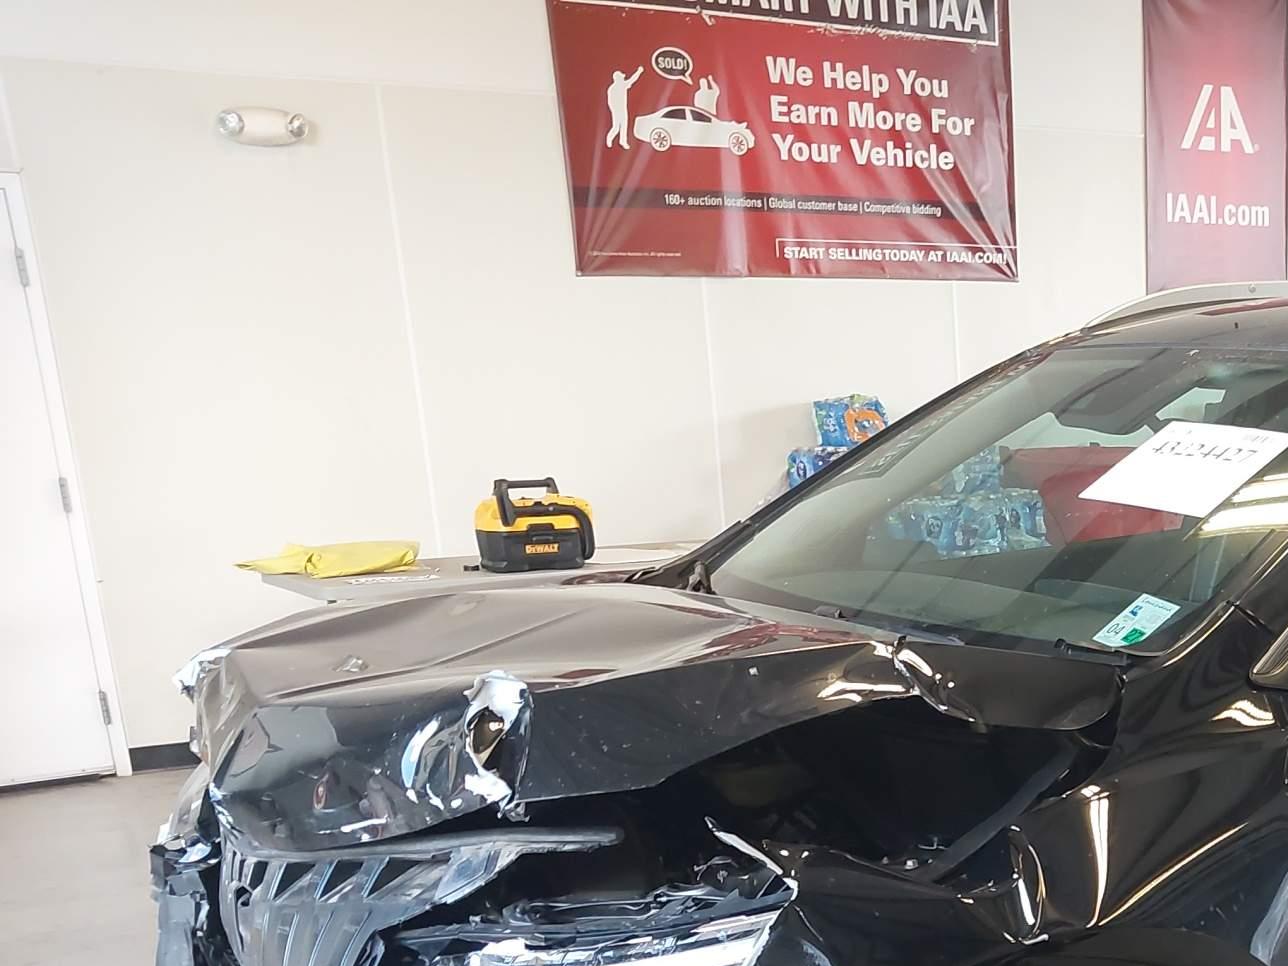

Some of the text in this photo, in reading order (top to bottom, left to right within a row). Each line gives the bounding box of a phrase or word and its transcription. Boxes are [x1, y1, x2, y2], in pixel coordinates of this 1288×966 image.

[657, 56, 688, 71] SOLD!
[765, 55, 949, 98] We Help You
[769, 95, 975, 136] Earn More For
[772, 133, 955, 170] Your Vehicle
[664, 193, 686, 206] 160+
[687, 194, 723, 207] auction
[723, 195, 762, 208] locations
[768, 197, 796, 210] Global
[797, 199, 836, 212] customer
[837, 201, 858, 212] base
[863, 201, 911, 216] Competitive
[911, 203, 942, 218] bidding
[1166, 192, 1270, 228] IAAI.com
[784, 246, 826, 259] START
[828, 247, 882, 261] SELLING
[882, 249, 925, 262] TODAY
[927, 250, 943, 262] AT
[1106, 623, 1126, 635] 04
